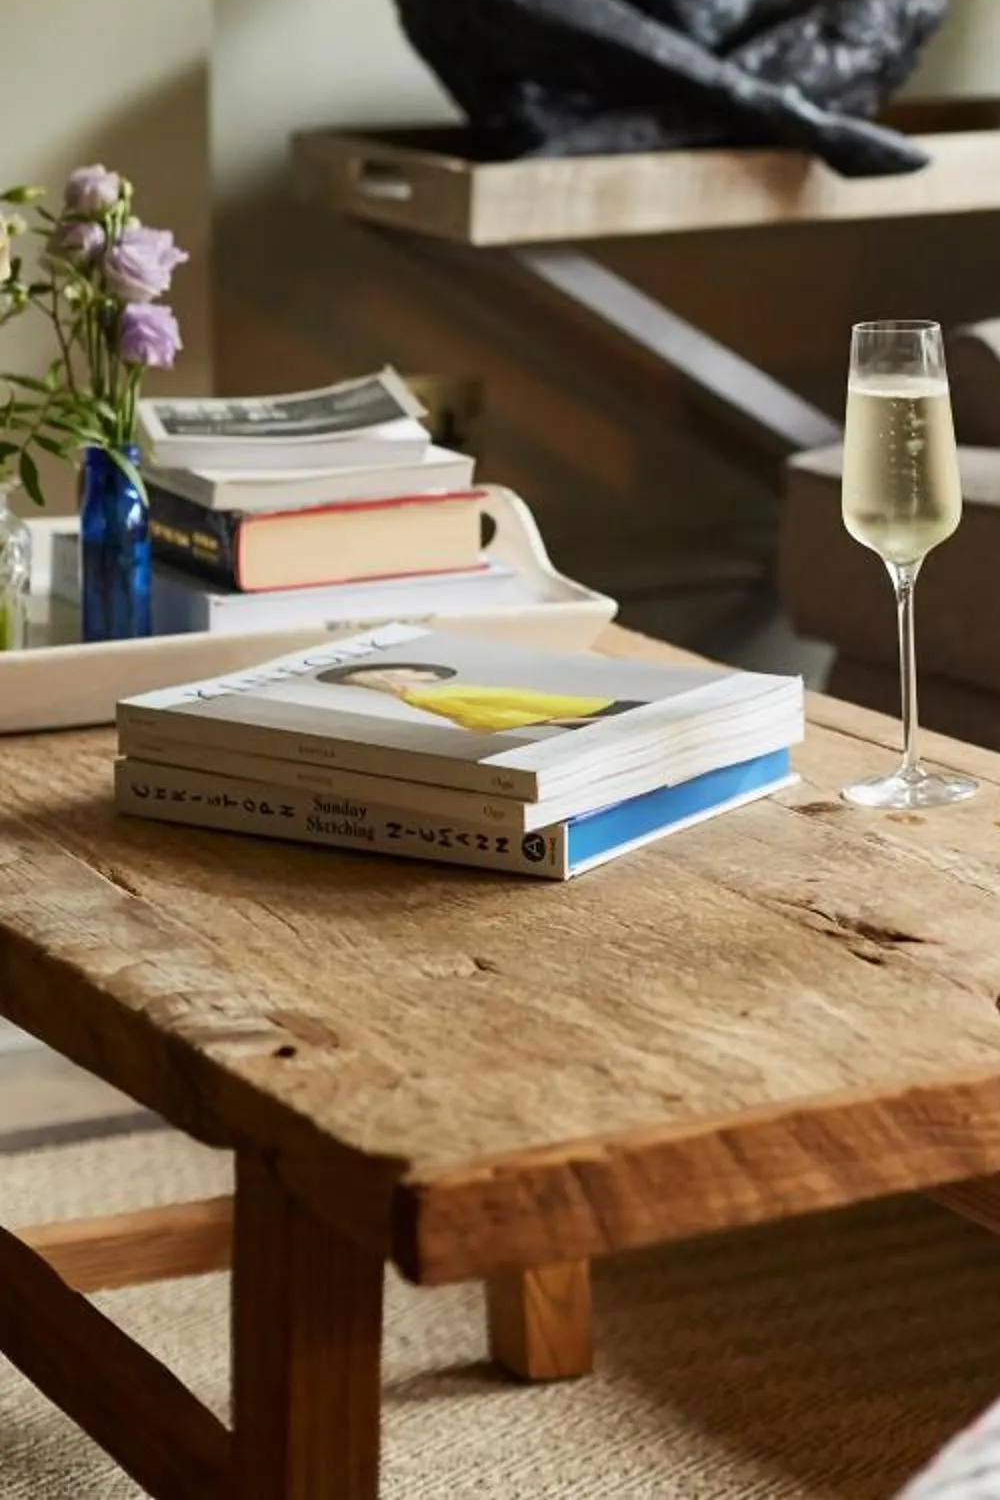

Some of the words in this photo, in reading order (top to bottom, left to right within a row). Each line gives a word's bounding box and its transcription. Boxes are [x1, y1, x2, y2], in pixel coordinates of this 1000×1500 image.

[131, 781, 295, 818] CHRISTOPH
[312, 795, 368, 819] Sunday
[306, 815, 375, 842] Sketching
[385, 821, 511, 854] NIEMANN
